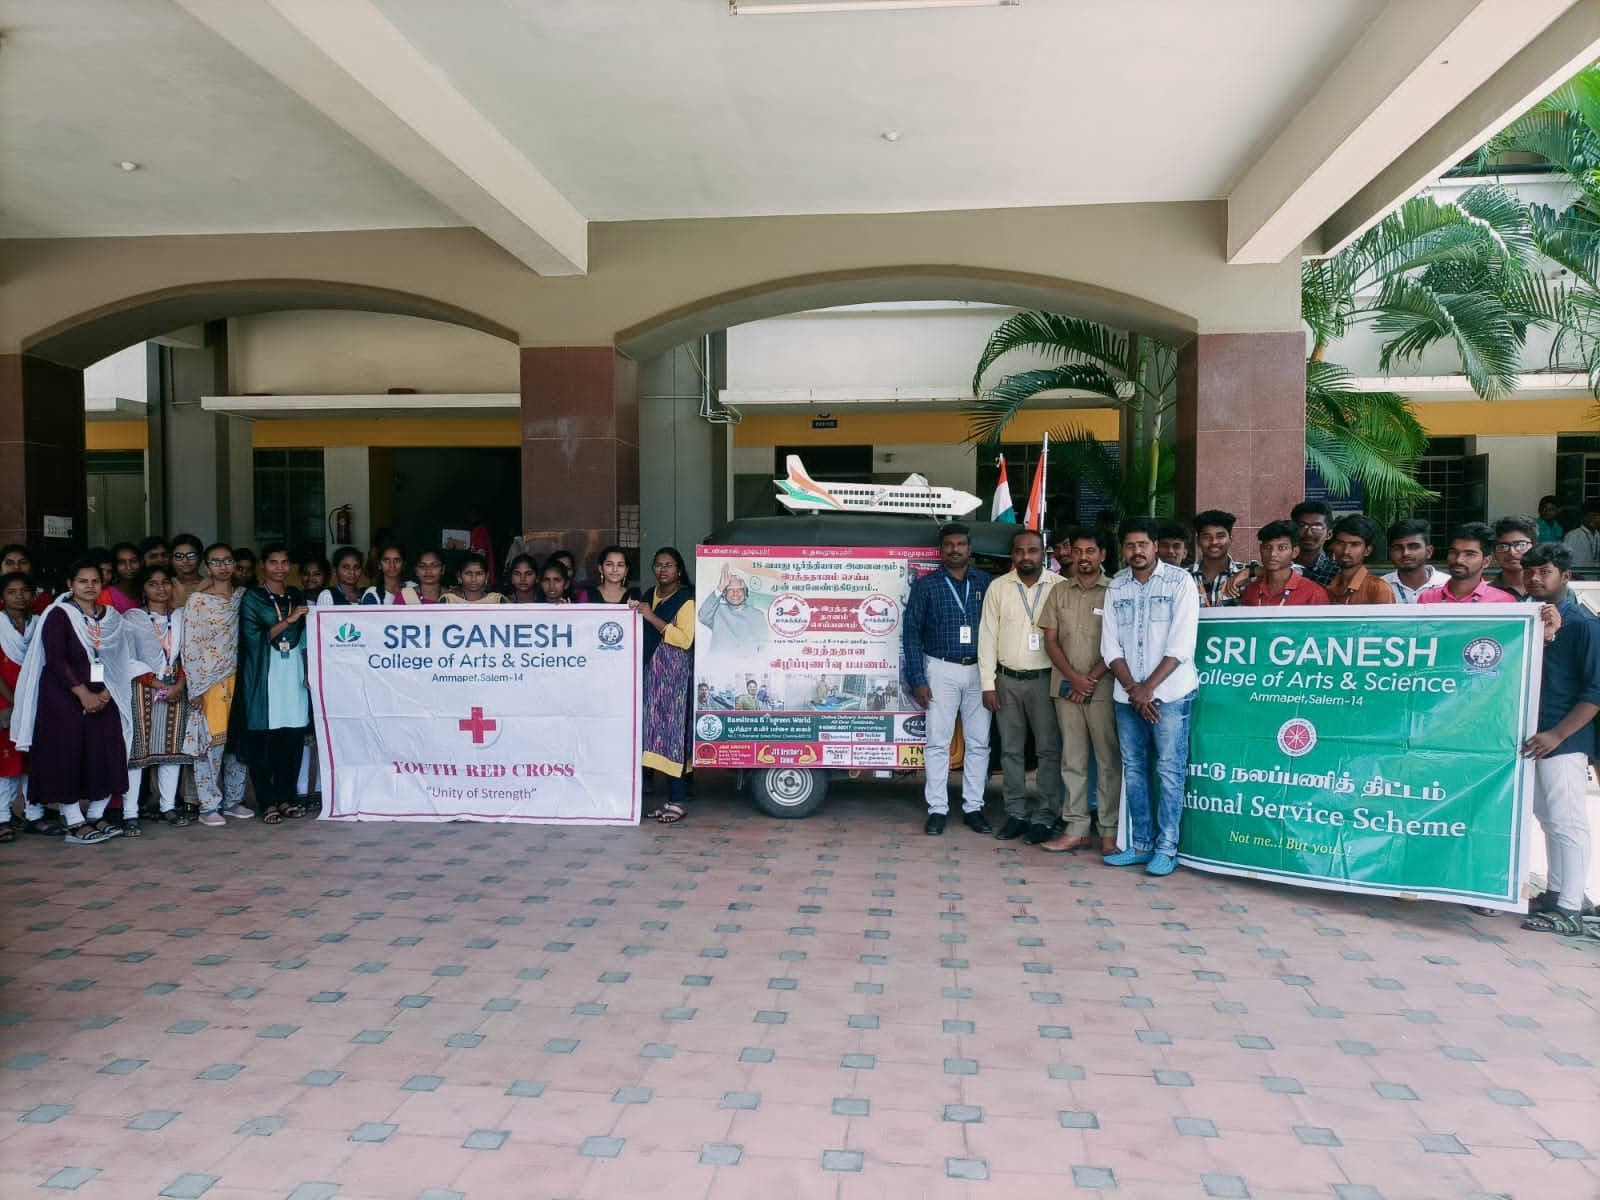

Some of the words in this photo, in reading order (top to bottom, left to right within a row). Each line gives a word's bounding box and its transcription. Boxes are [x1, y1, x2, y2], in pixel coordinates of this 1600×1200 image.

[776, 607, 784, 616] 3
[383, 624, 431, 649] SRI
[442, 624, 573, 649] GANESH
[801, 644, 866, 657] இரத்ததான
[1205, 636, 1257, 665] SRI
[1269, 636, 1439, 668] GANESH
[368, 653, 433, 670] College
[438, 653, 455, 668] of
[459, 653, 497, 668] Arts
[502, 653, 516, 668] &
[521, 652, 587, 668] Science
[1197, 668, 1257, 687] ollege
[1262, 669, 1283, 688] of
[1287, 671, 1334, 690] Arts
[1340, 672, 1358, 690] &
[1364, 672, 1457, 693] Science
[909, 746, 924, 754] TN
[392, 760, 458, 777] YOUTH
[466, 763, 506, 778] RED
[512, 763, 576, 777] CROSS
[1186, 763, 1226, 781] ாட்டு
[1230, 765, 1355, 793] நலப்பணித்
[1361, 776, 1447, 802] திட்டம்
[467, 787, 479, 799] of
[1183, 792, 1243, 815] tional
[1250, 796, 1344, 827] Service
[1353, 808, 1467, 837] Scheme
[1228, 831, 1250, 845] Not
[1286, 838, 1309, 852] But
